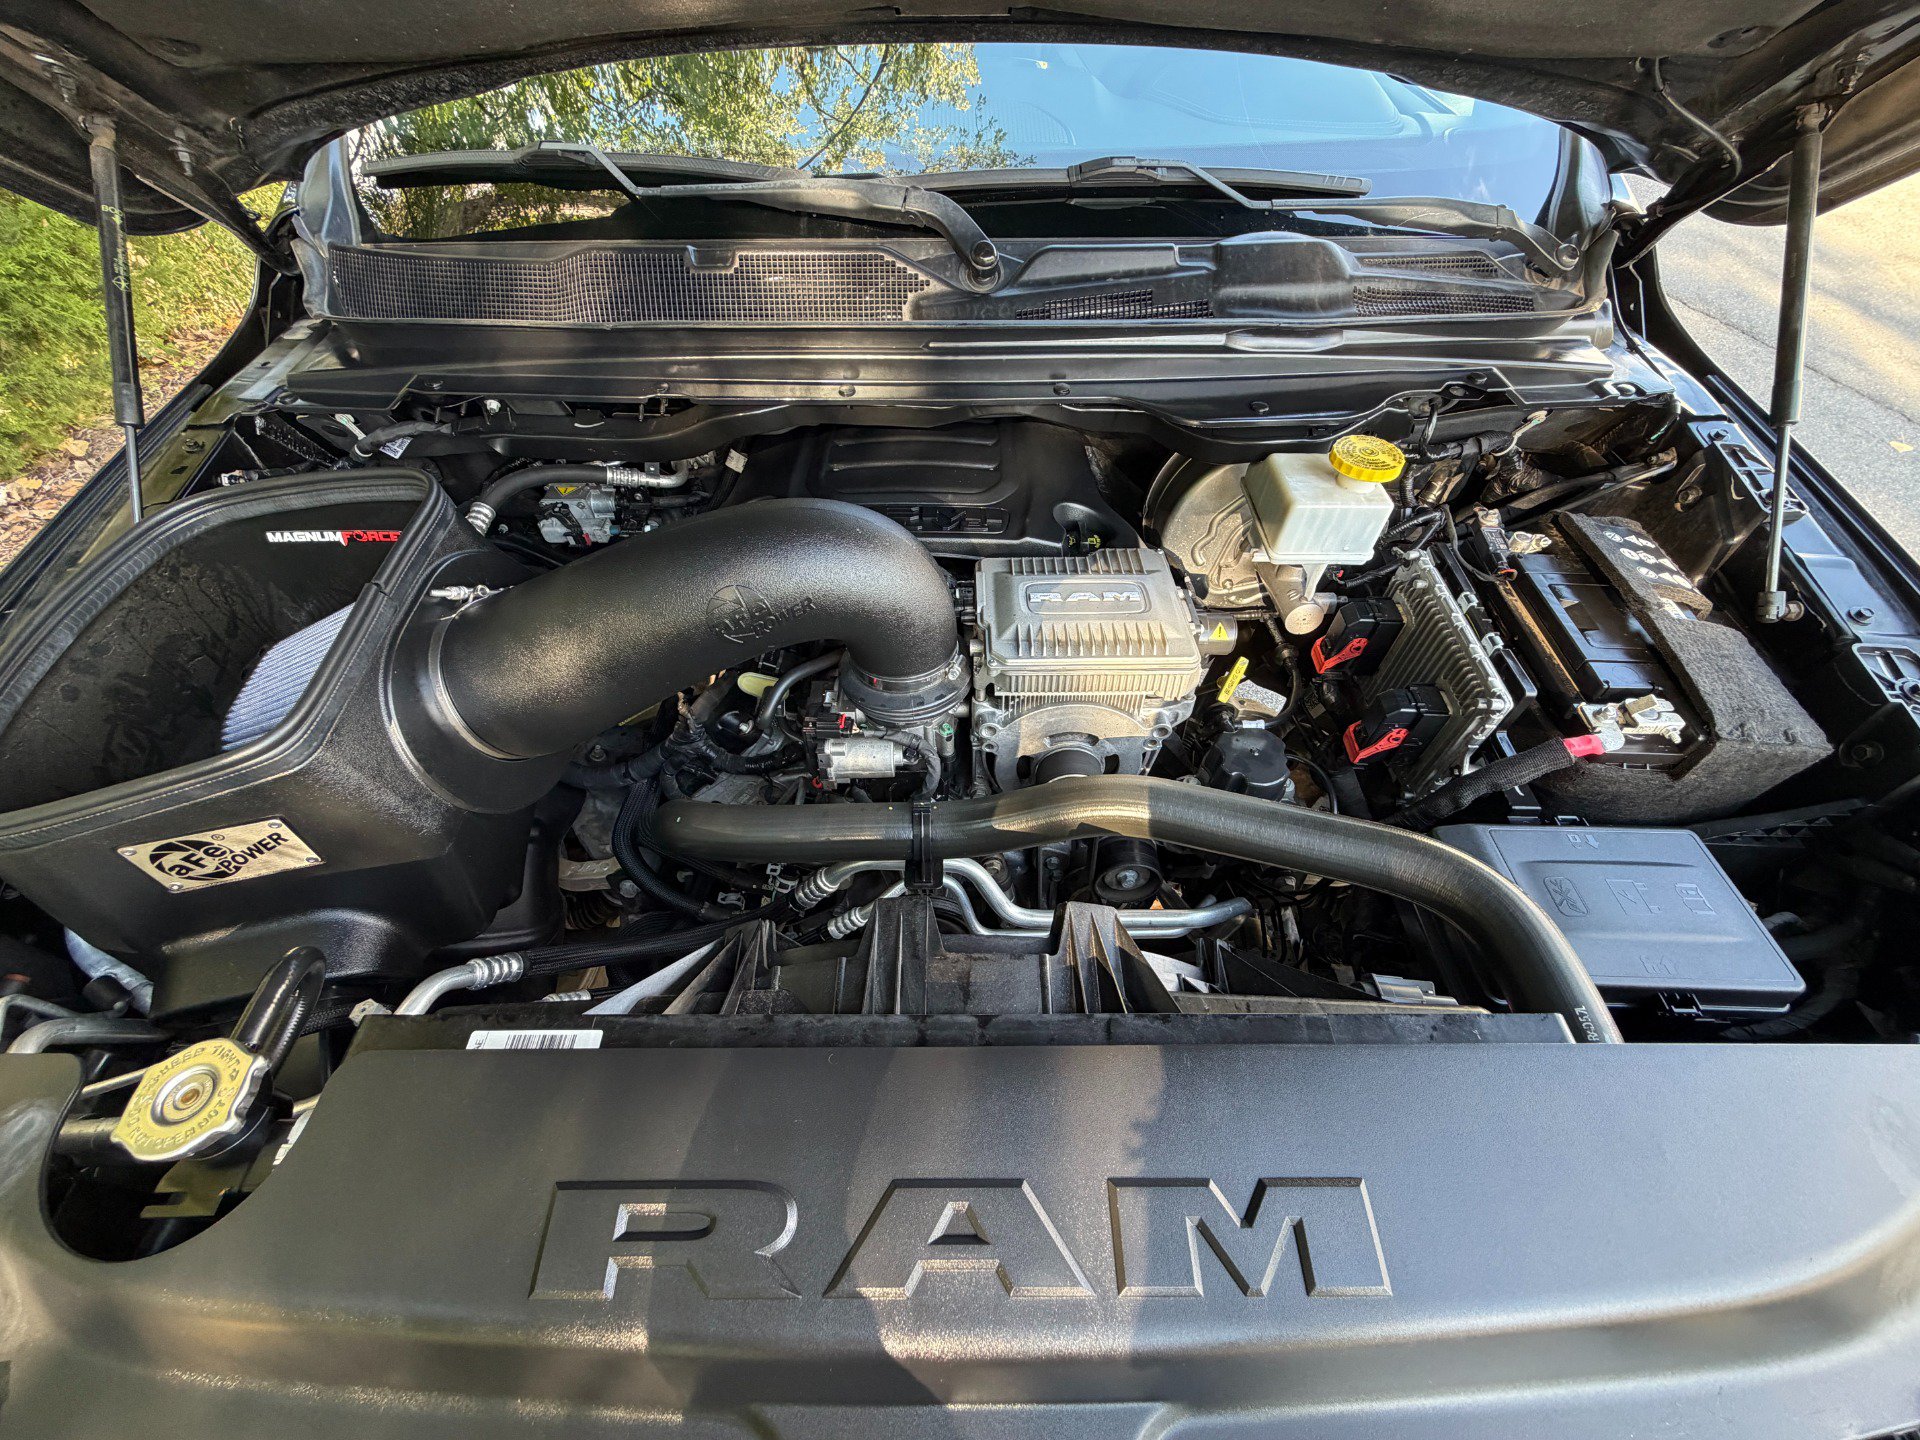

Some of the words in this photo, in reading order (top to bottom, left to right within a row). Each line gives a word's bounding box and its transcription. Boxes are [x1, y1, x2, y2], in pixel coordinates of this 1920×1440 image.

[1029, 592, 1141, 603] RAM
[168, 844, 225, 877] aFe
[219, 832, 289, 873] POWER
[212, 1044, 241, 1070] TIGHT
[527, 1177, 1393, 1299] RAM
